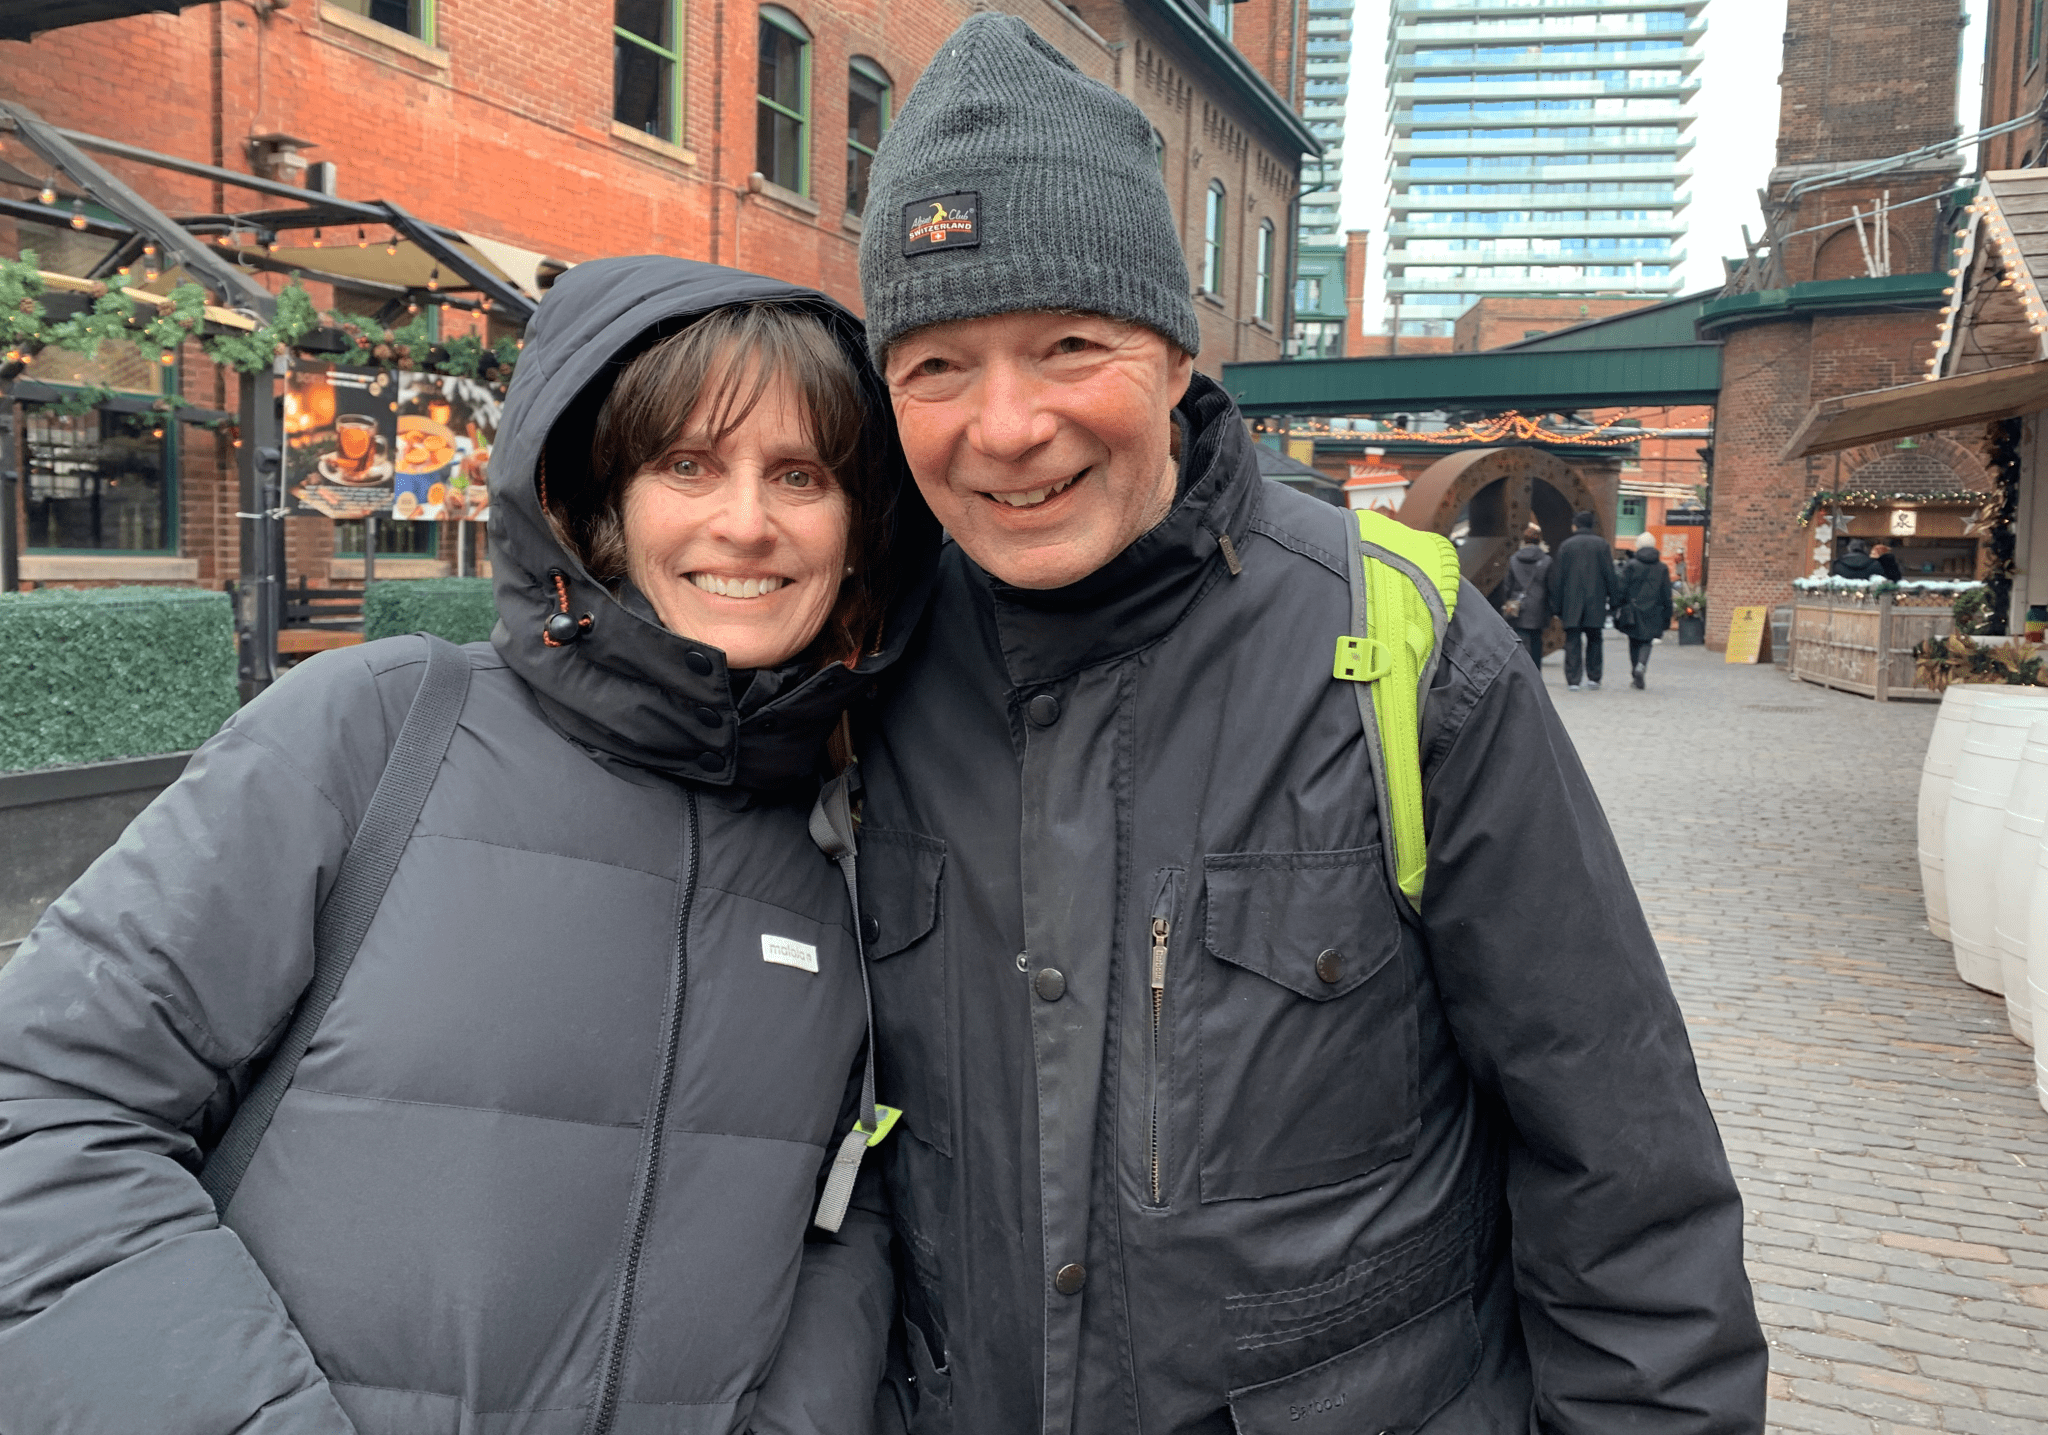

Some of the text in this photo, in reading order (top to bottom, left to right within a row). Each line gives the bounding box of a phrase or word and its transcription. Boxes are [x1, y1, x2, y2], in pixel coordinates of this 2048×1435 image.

[948, 208, 969, 220] Club
[908, 222, 972, 240] SWITZERLAND
[1289, 1393, 1346, 1422] Barbour
